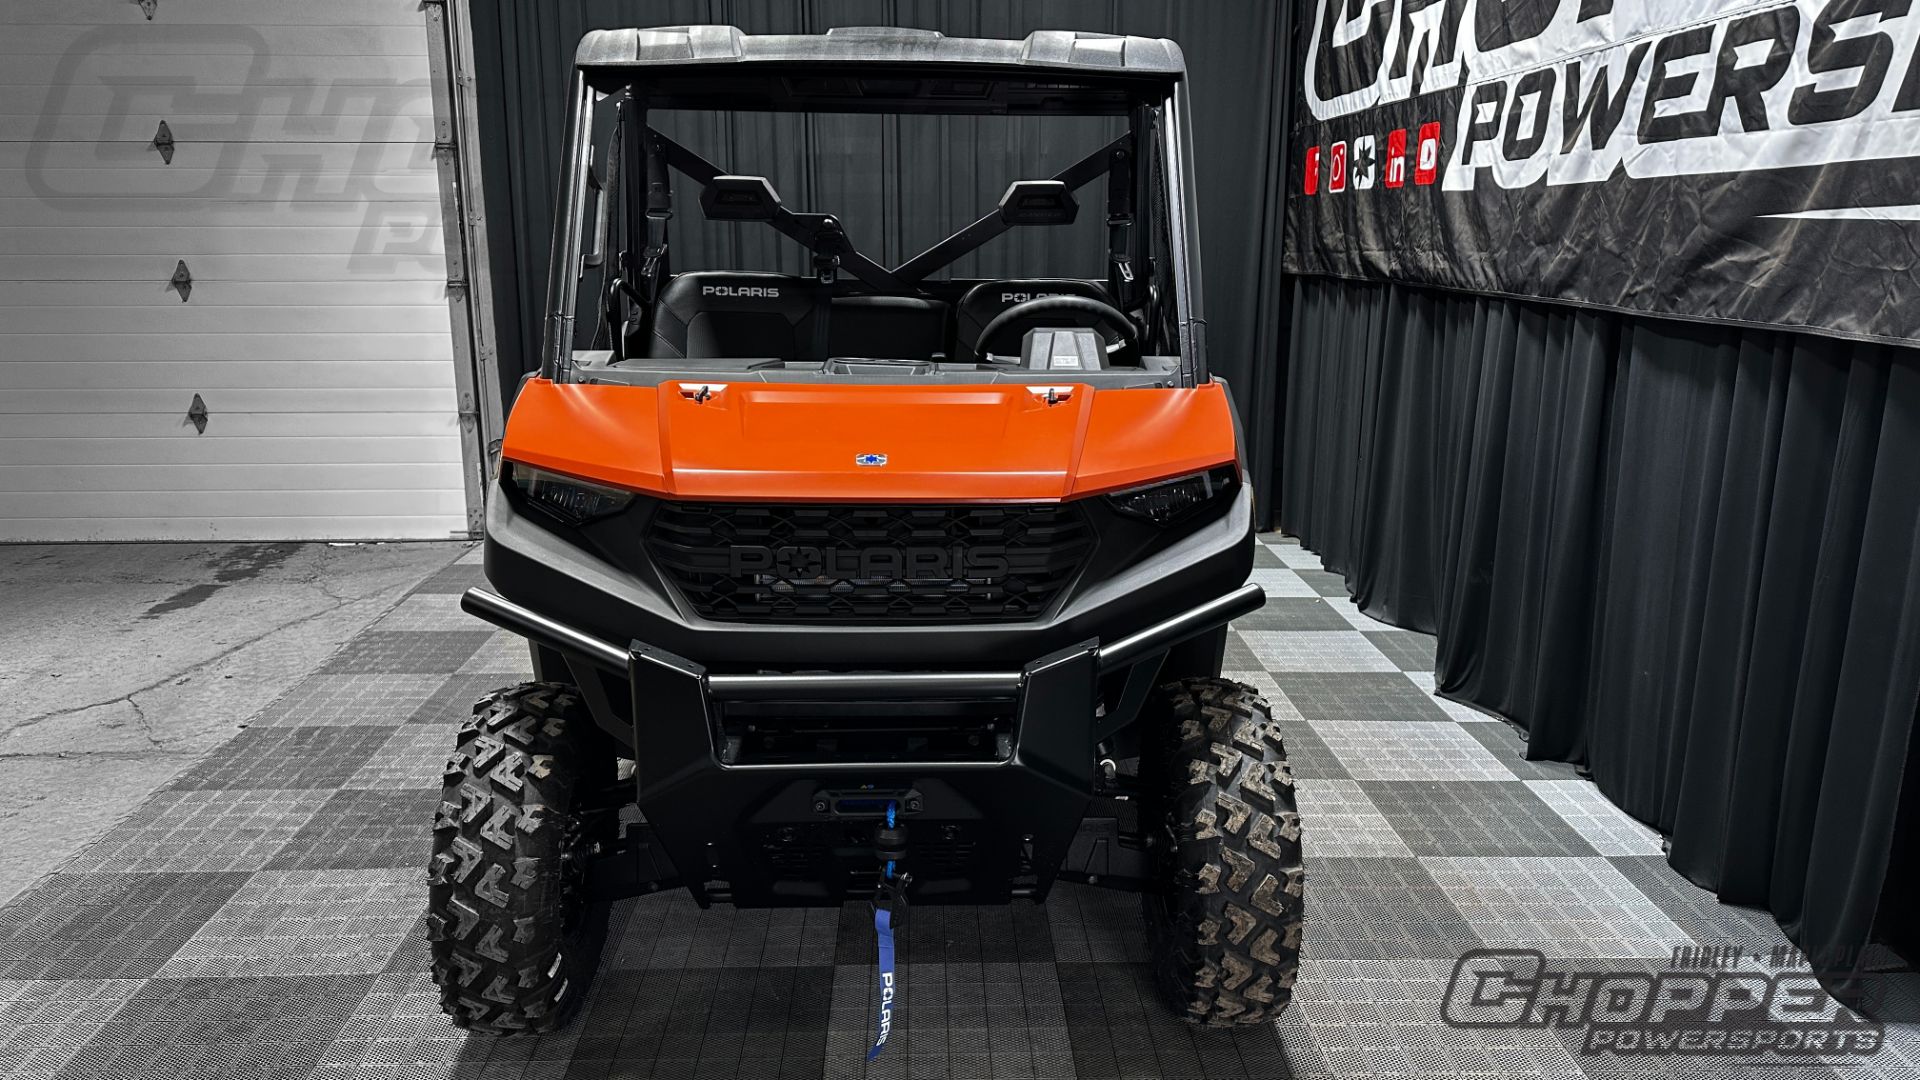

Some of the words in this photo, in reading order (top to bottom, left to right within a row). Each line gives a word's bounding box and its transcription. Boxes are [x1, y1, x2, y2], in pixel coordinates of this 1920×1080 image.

[702, 286, 780, 298] POLARIS
[729, 545, 1009, 579] POLARIS
[876, 972, 893, 1046] POLARIS
